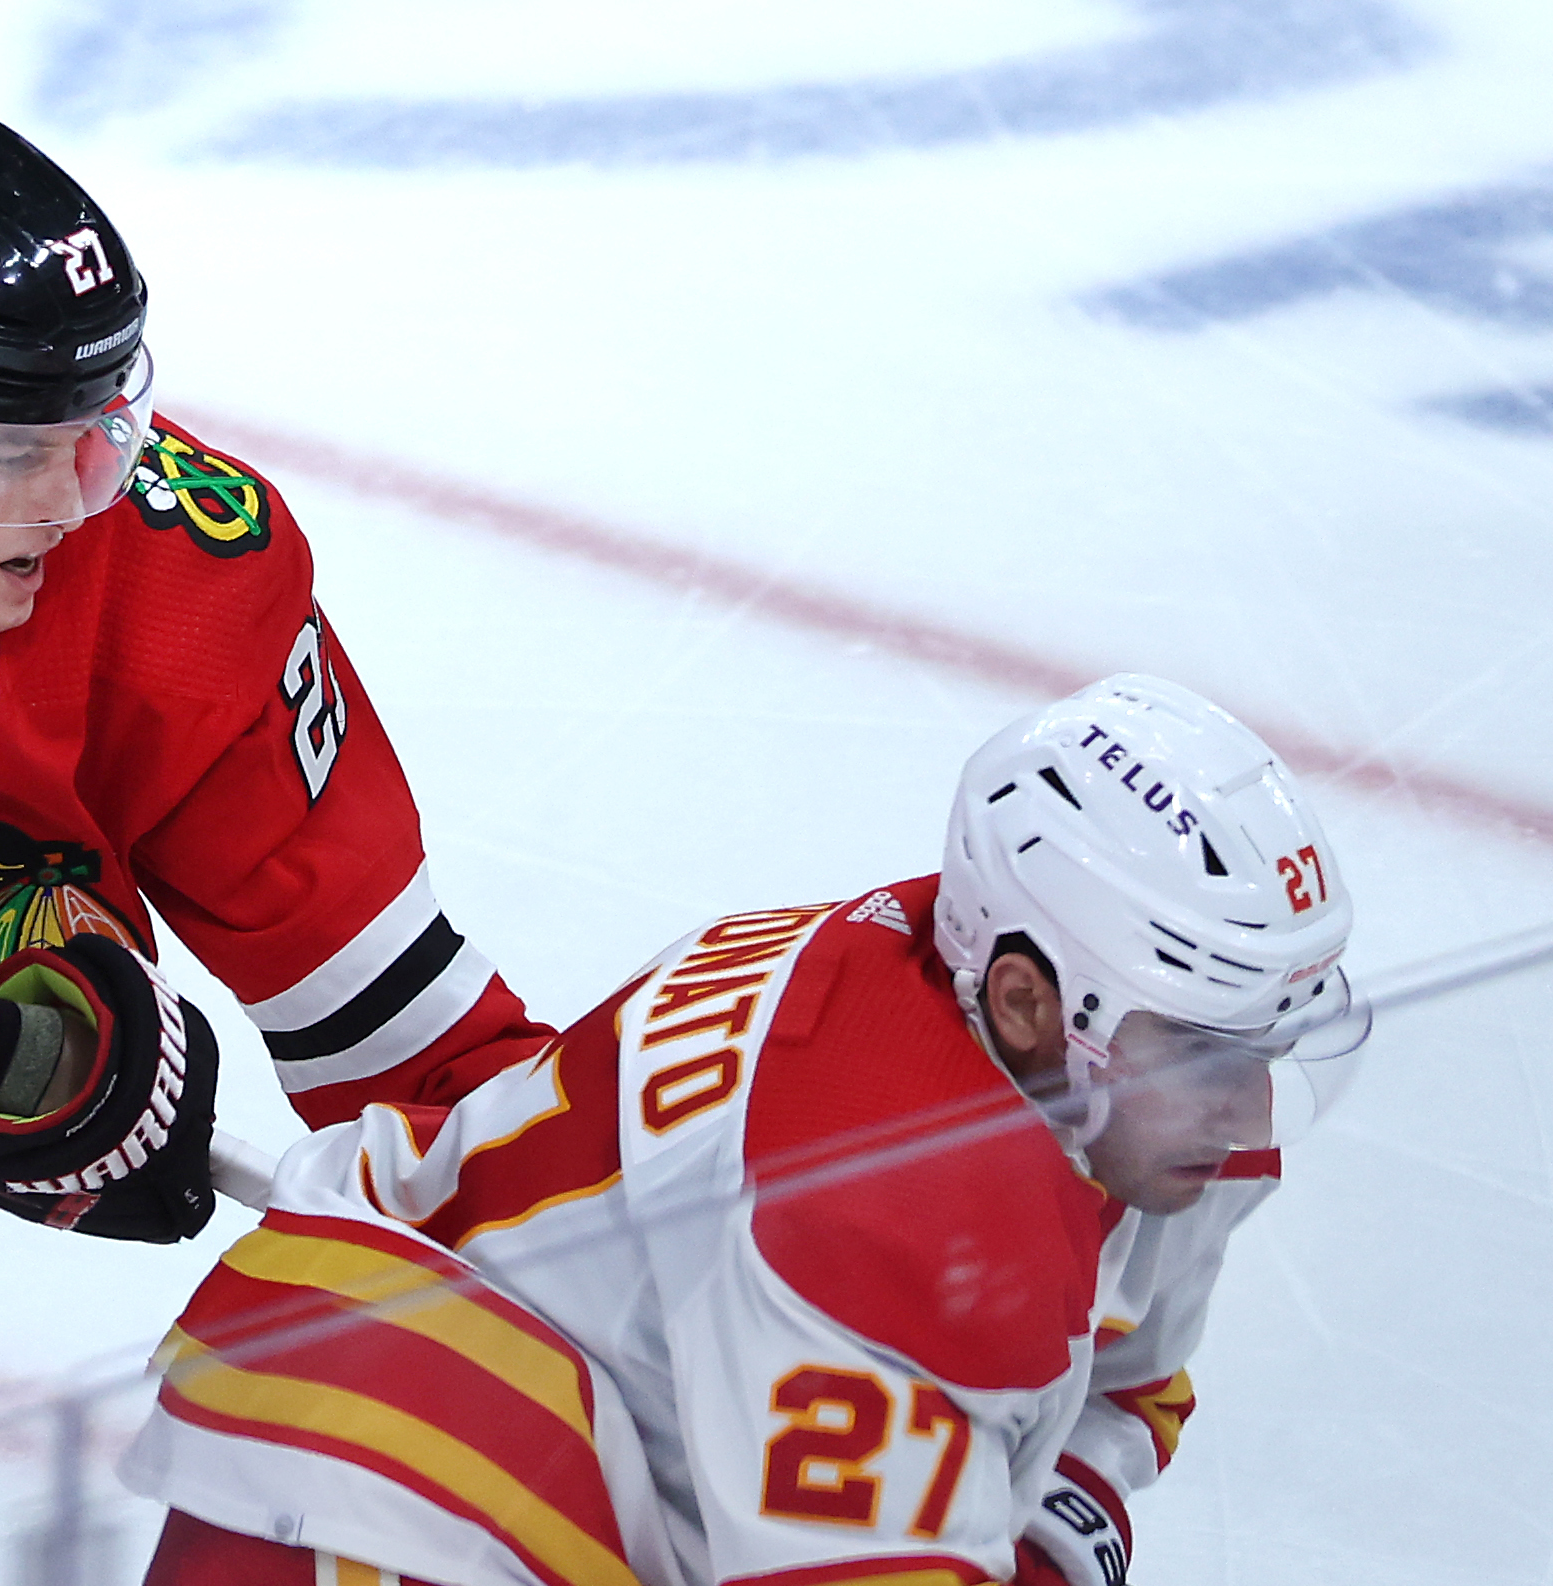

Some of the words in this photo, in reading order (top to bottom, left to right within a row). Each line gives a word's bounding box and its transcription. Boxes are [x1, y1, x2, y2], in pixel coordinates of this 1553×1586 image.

[48, 226, 116, 297] 27
[279, 597, 347, 808] 2
[1079, 723, 1199, 836] TELUS
[1276, 844, 1327, 914] 27
[759, 1362, 974, 1540] 27
